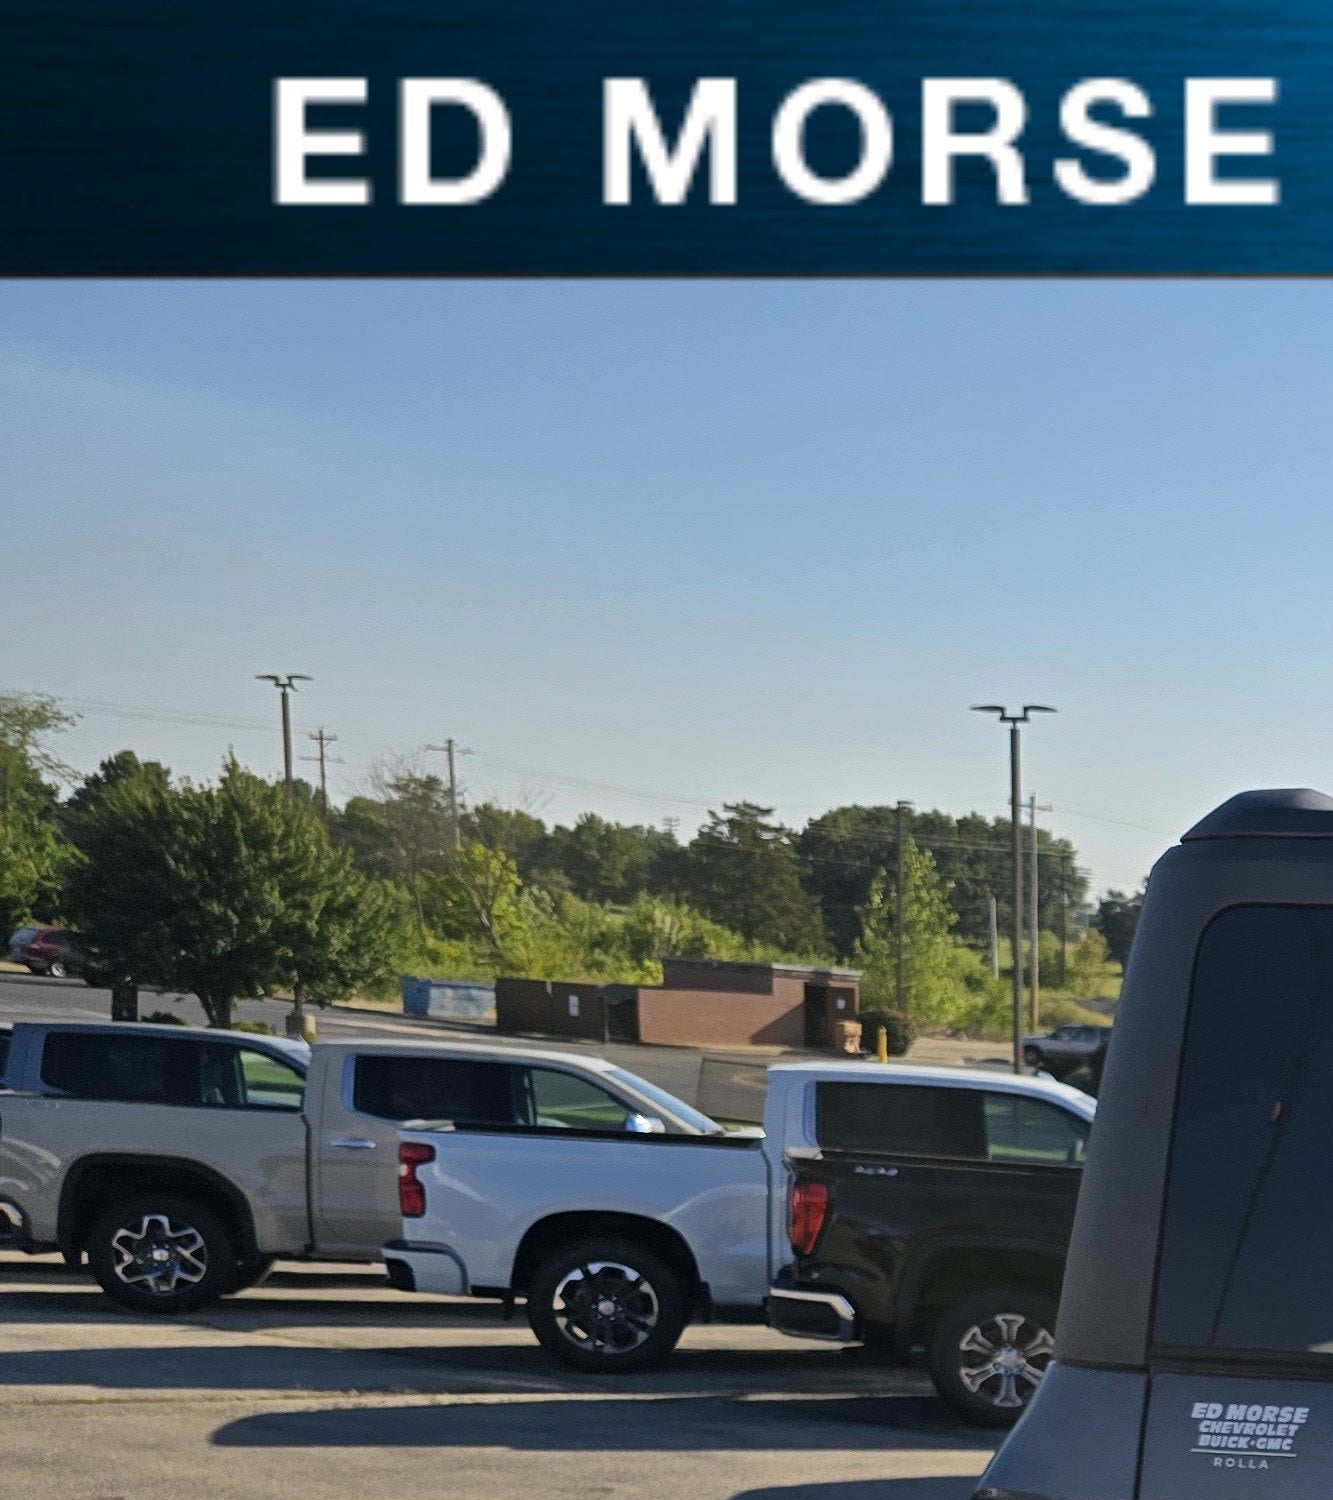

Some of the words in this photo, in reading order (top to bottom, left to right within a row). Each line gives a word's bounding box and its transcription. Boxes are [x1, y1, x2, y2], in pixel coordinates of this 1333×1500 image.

[1191, 1402, 1223, 1419] ED
[1225, 1403, 1310, 1424] MORSE
[1199, 1420, 1299, 1437] CHEVROLET
[1213, 1456, 1269, 1469] ROLLA
